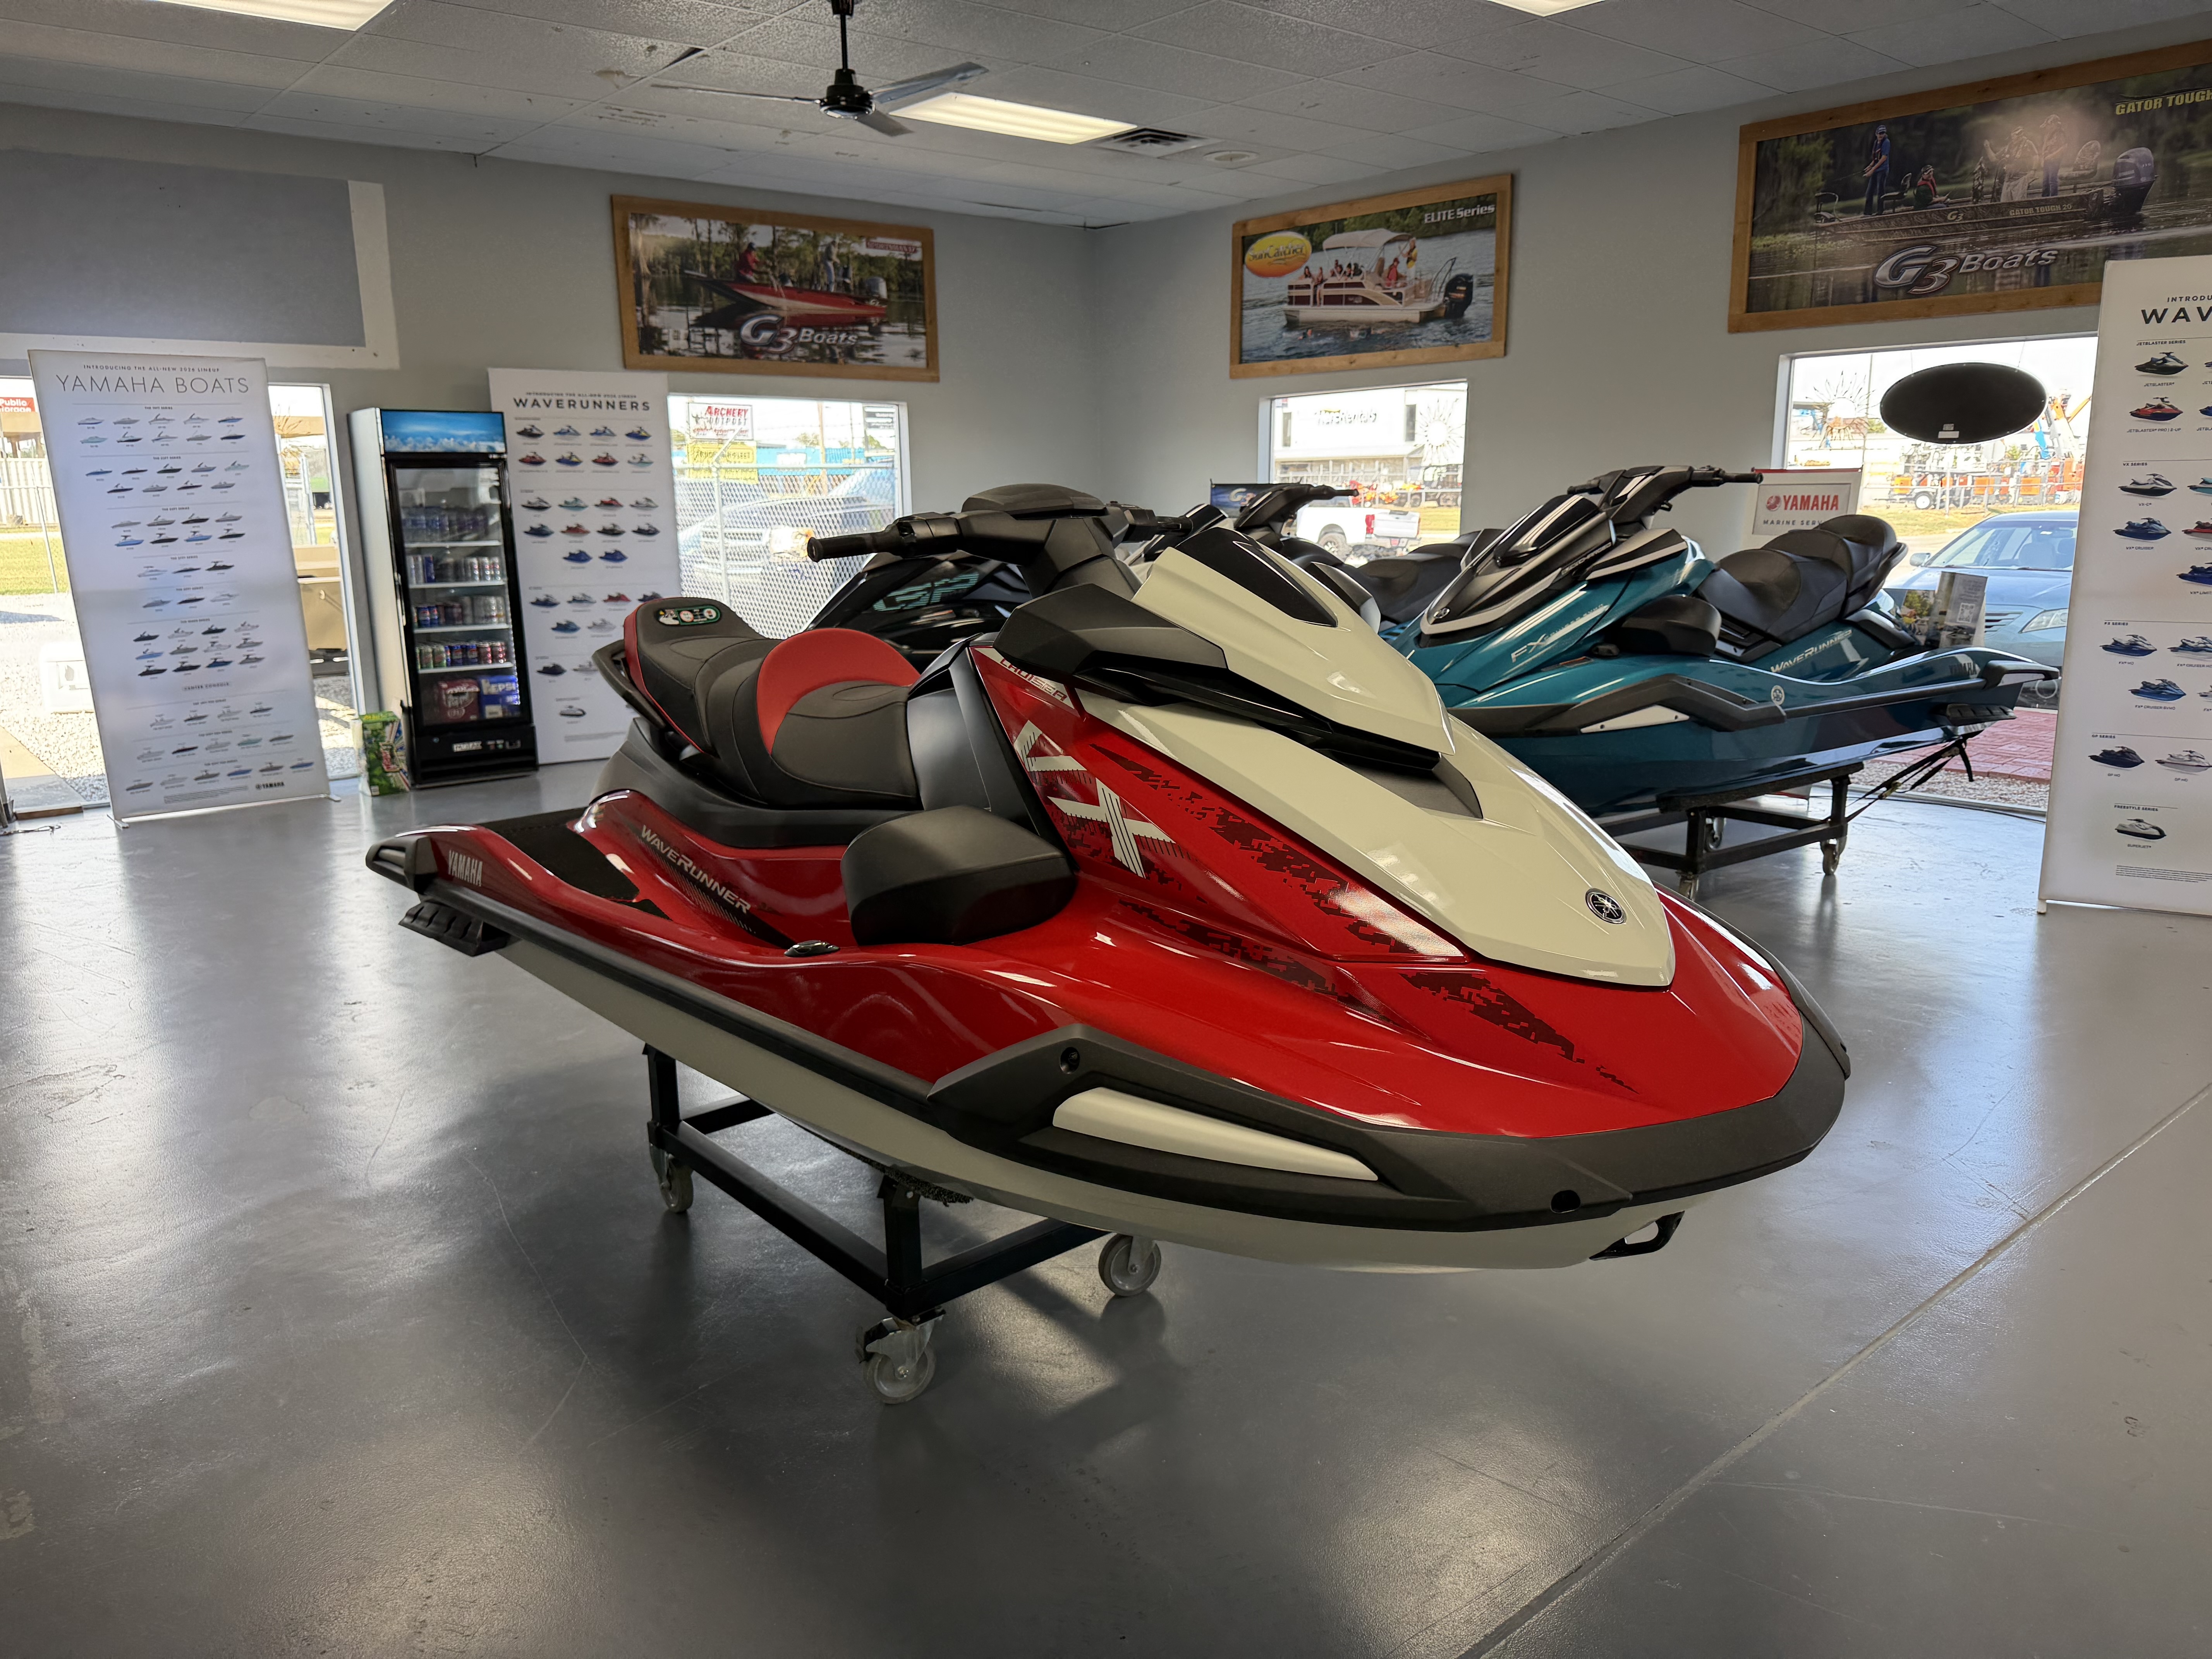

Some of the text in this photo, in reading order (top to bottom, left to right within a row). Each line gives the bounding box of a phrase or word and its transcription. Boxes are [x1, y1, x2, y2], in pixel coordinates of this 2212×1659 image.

[2116, 98, 2163, 115] GATOR
[1424, 204, 1496, 223] ELITE Series
[1947, 211, 1965, 222] G3
[2009, 207, 2034, 216] GATOR
[2035, 204, 2061, 213] TOUGH
[1874, 245, 2059, 294] G3 Boats
[740, 314, 859, 354] G3 Boats
[56, 374, 249, 393] YAMAHA BOATS
[513, 397, 650, 411] WAVERUNNERS
[705, 406, 748, 417] ARCHERY
[1783, 495, 1839, 510] YAMAHA
[1511, 633, 1546, 663] FX
[1000, 658, 1068, 701] CRUISER
[448, 850, 483, 887] YAMAHA
[642, 824, 751, 914] WAVERUNNER
